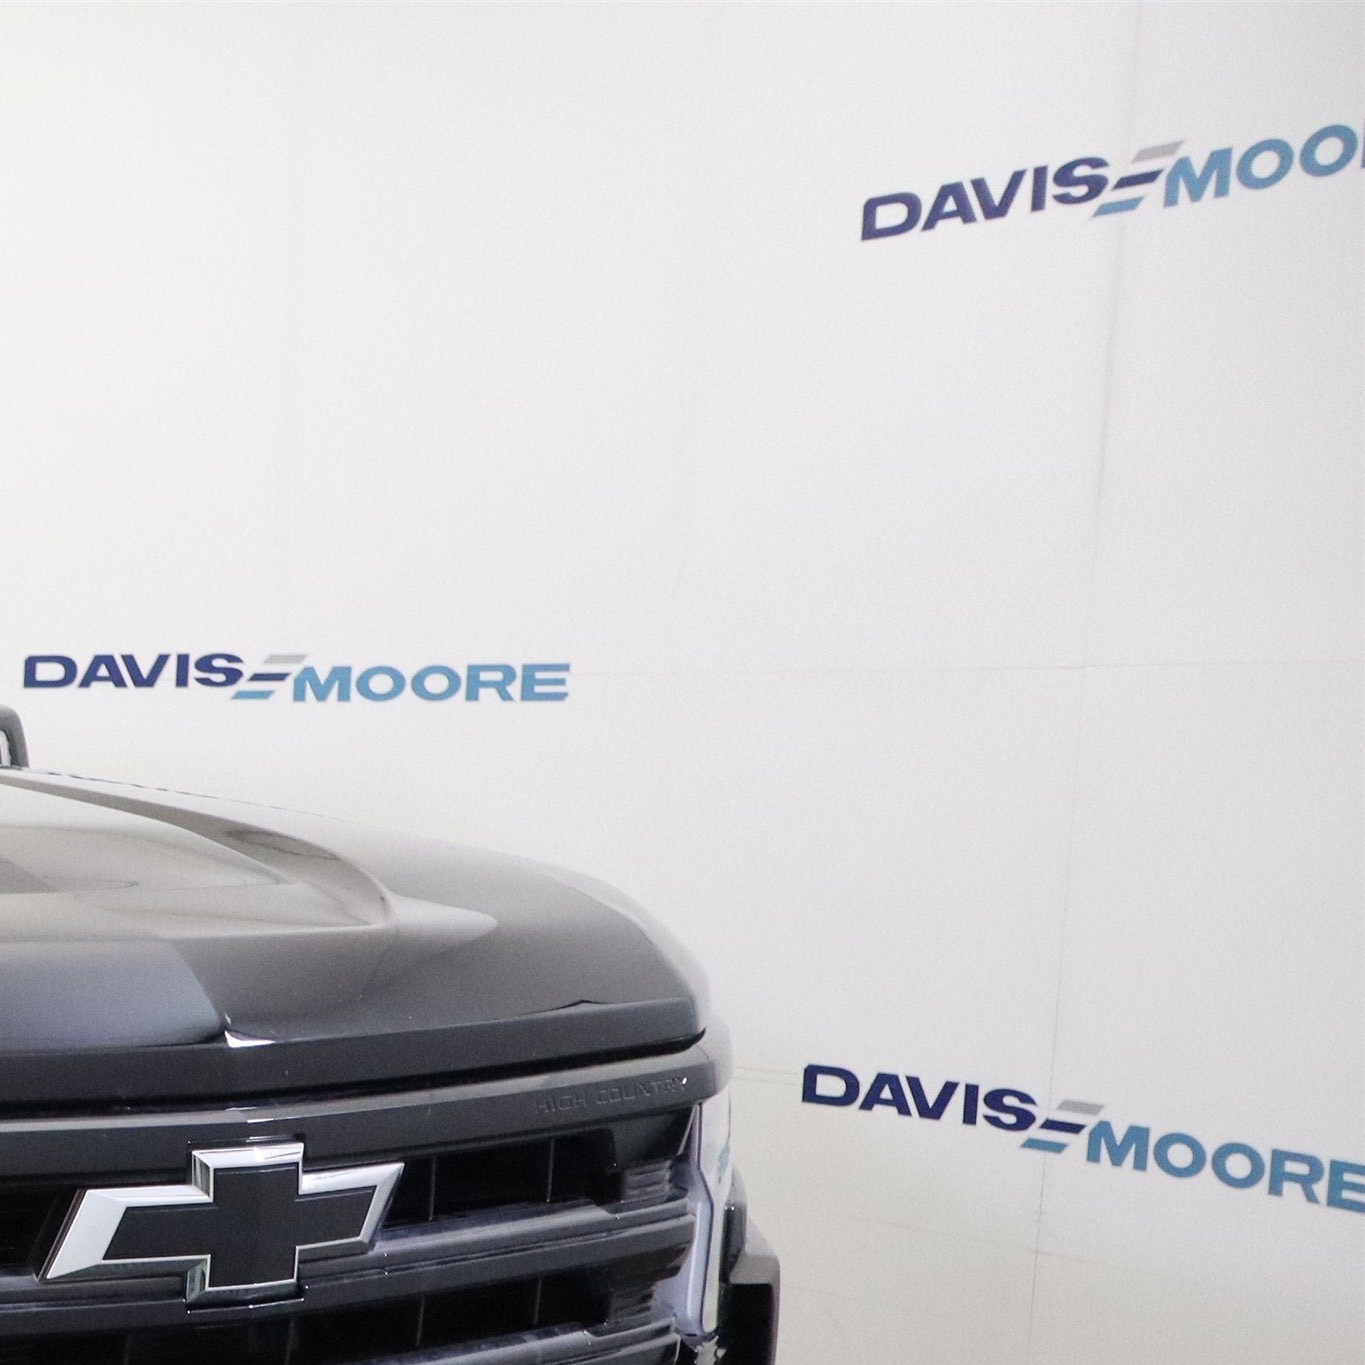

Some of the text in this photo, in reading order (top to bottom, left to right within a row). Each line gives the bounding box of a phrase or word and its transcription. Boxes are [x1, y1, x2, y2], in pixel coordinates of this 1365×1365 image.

[861, 123, 1365, 242] DAVIS MOO
[23, 652, 572, 702] DAVIS MOORE
[802, 1063, 1365, 1214] DAVIS MOORE
